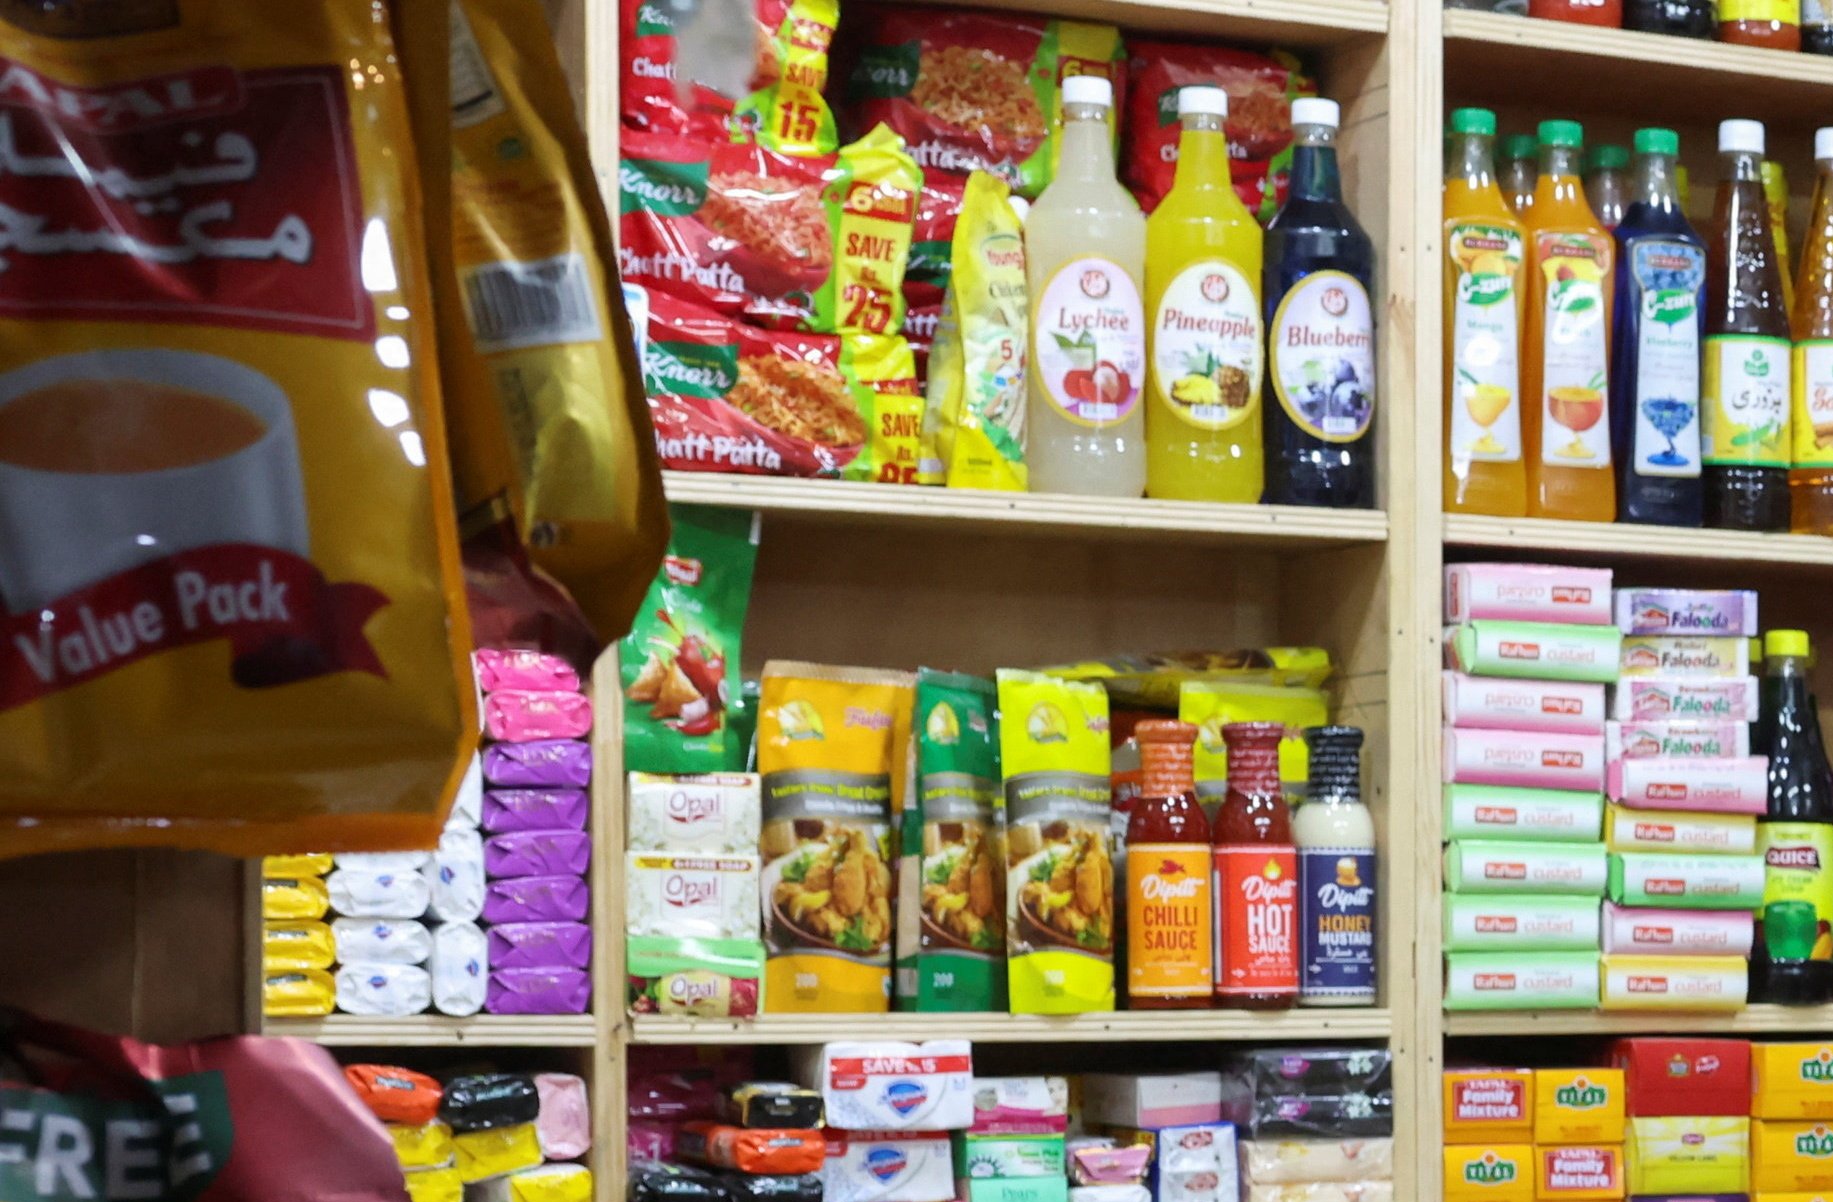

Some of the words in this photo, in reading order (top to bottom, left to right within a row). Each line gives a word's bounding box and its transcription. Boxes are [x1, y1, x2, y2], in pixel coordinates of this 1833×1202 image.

[847, 233, 895, 262] SAVE
[843, 286, 892, 334] 25
[1059, 307, 1130, 333] Lychee
[1162, 308, 1257, 340] Pineapple
[15, 587, 162, 686] Value
[173, 558, 291, 633] Pack
[669, 791, 722, 822] Opal
[665, 876, 717, 906] Opal
[1143, 906, 1199, 927] CHILLI
[1247, 904, 1293, 935] HOT
[1318, 915, 1371, 932] HONEY
[1144, 930, 1197, 950] SAUCE
[1248, 935, 1290, 953] SAUCE
[1462, 1090, 1515, 1105] Family
[1458, 1103, 1519, 1118] Mixture
[1554, 1159, 1604, 1174] Family
[1550, 1173, 1610, 1189] Mixture
